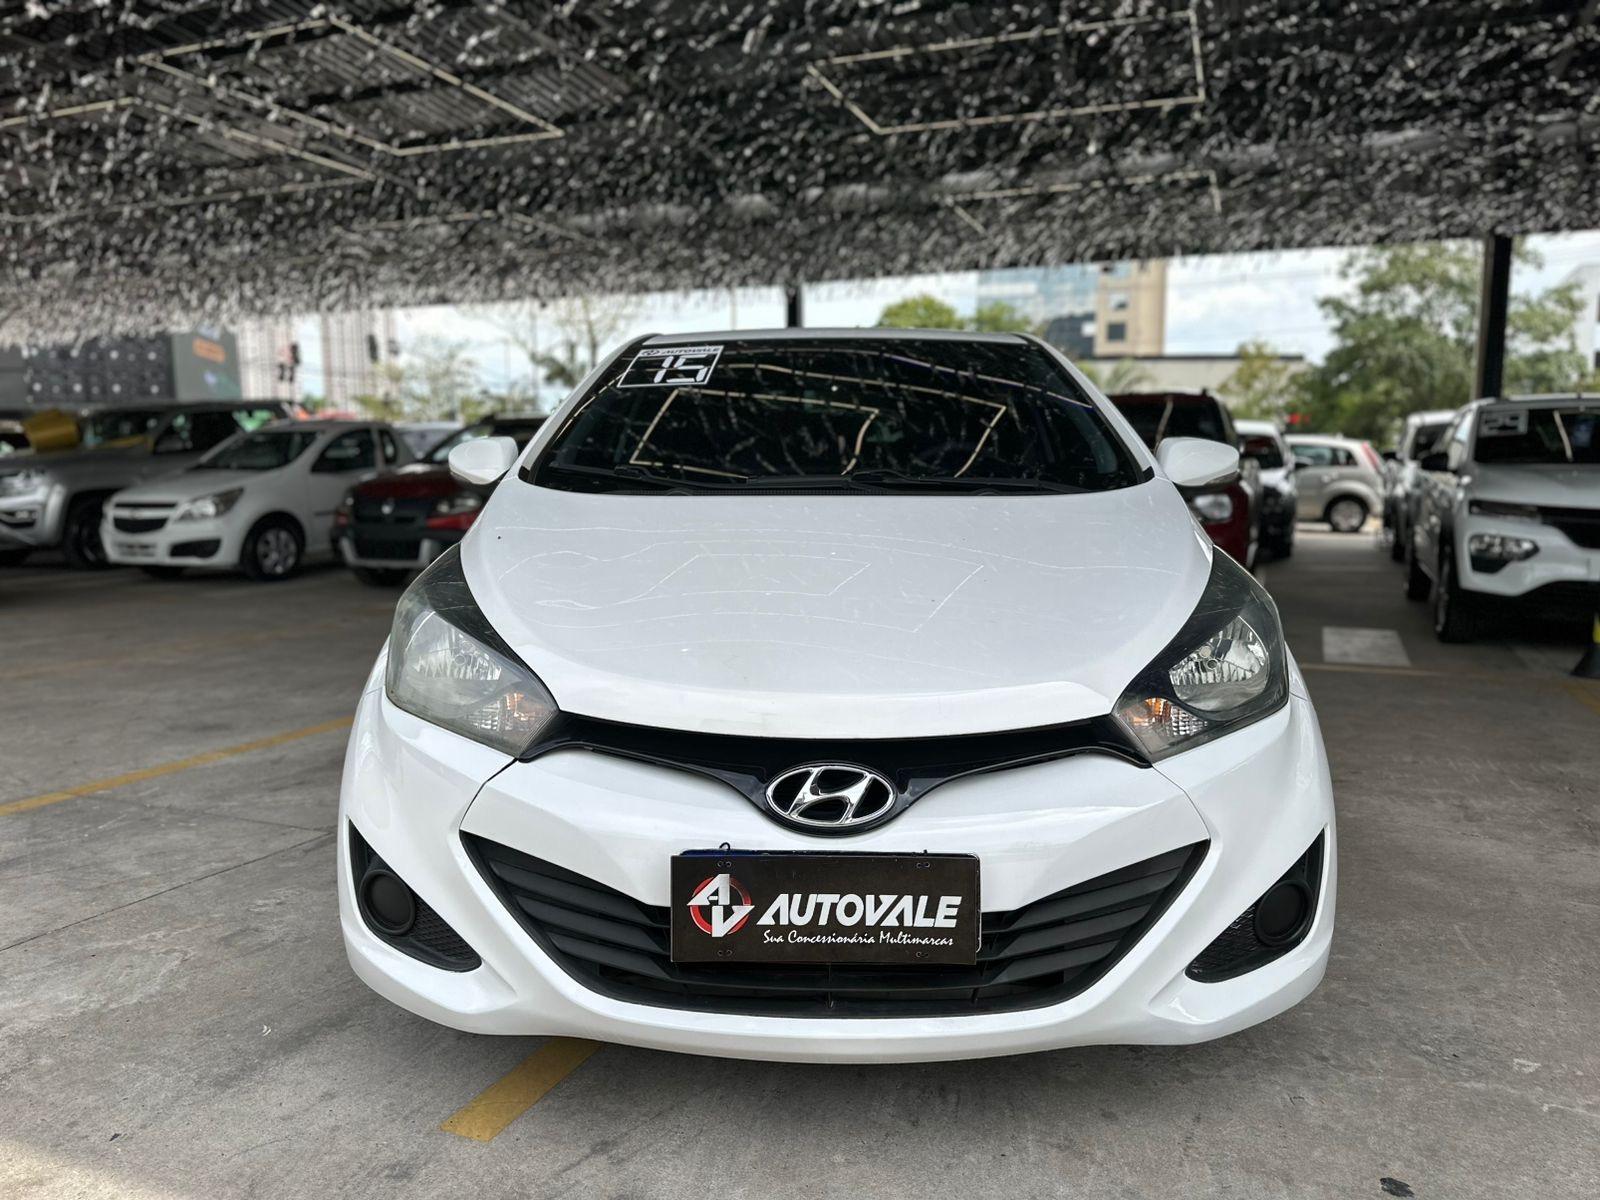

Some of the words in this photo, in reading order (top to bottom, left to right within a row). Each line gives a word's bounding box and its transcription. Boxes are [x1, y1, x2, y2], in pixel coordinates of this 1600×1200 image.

[654, 354, 708, 383] 15
[757, 894, 962, 928] AUTOVALE
[764, 930, 785, 943] Sua
[788, 930, 875, 944] Concessionária
[879, 930, 955, 946] Multimarcas
